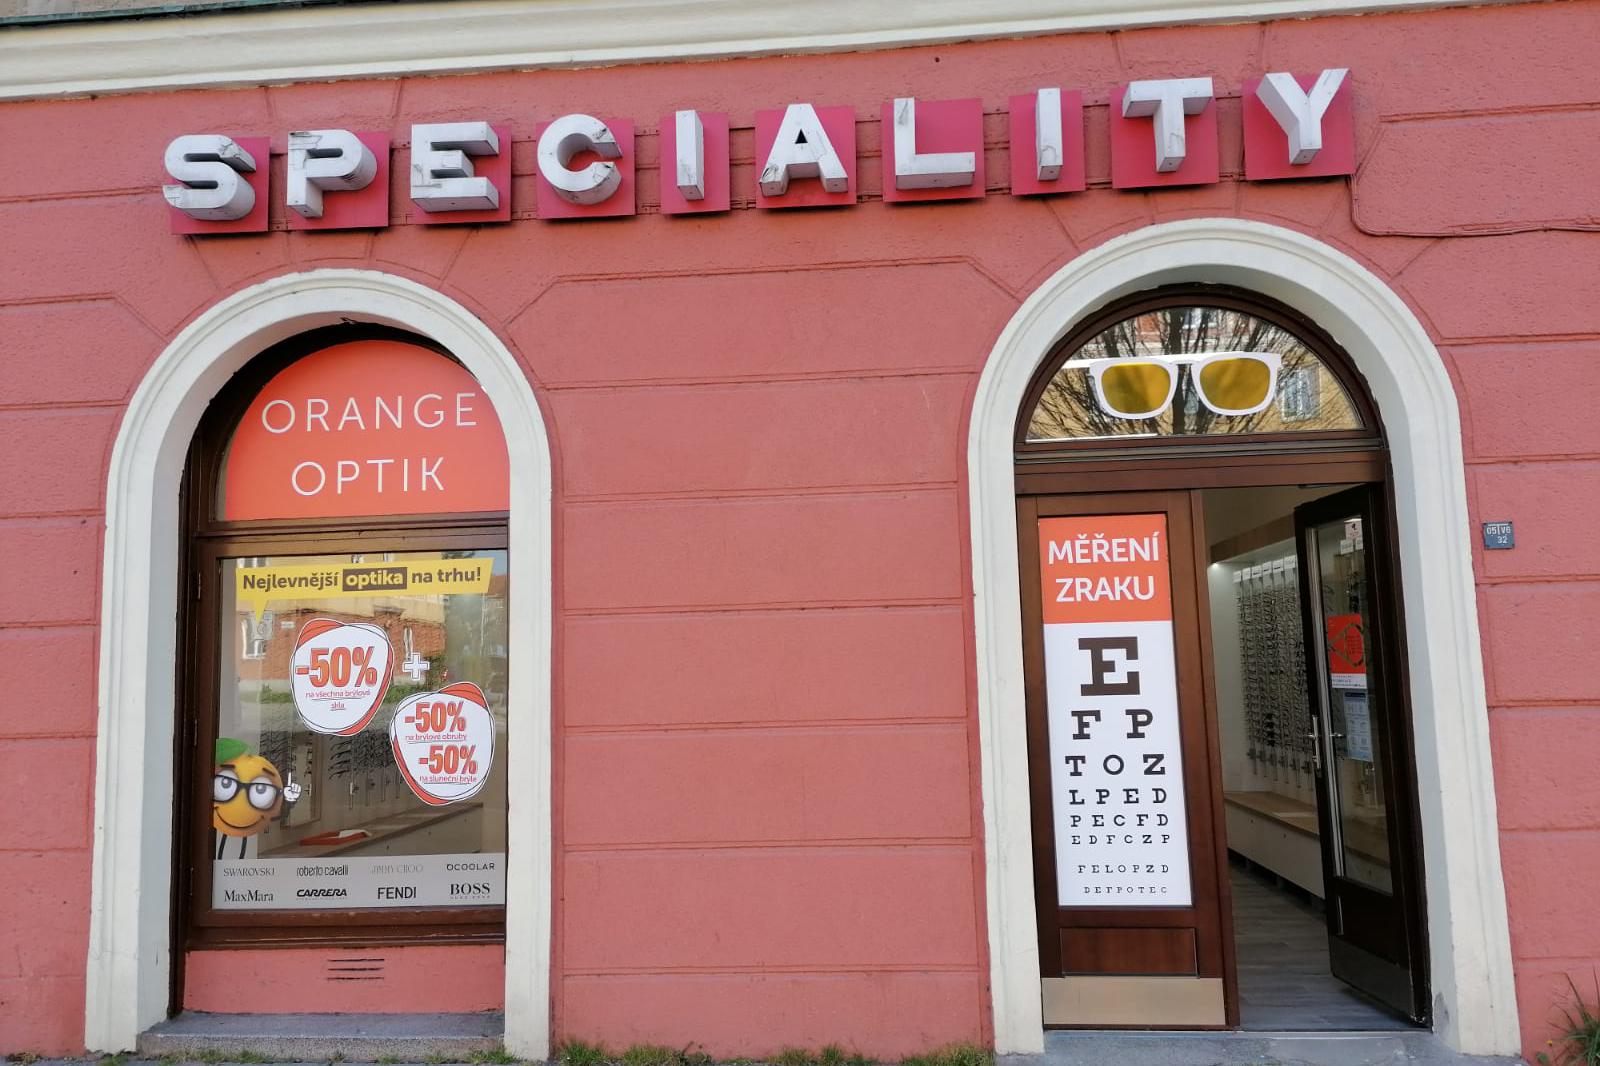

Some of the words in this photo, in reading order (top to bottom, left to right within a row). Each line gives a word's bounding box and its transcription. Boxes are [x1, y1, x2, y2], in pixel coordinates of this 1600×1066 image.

[161, 67, 1350, 223] SPECIALITY
[261, 392, 478, 434] ORANGE
[291, 456, 445, 496] OPTIK
[1048, 531, 1160, 564] MĚŘENÍ
[242, 571, 339, 592] Nejlevnější
[345, 569, 404, 588] optika
[412, 570, 434, 584] na
[437, 566, 481, 583] trhu!
[1055, 575, 1155, 602] ZRAKU
[295, 646, 378, 688] -50%
[1078, 636, 1140, 696] E
[404, 701, 466, 733] -50%
[418, 745, 478, 775] -50%
[296, 866, 323, 877] roberto
[324, 864, 349, 876] cavalli
[224, 889, 274, 903] MaxMara
[296, 888, 347, 898] CARRERA
[377, 886, 417, 900] FENDI
[450, 882, 491, 896] BOSS
